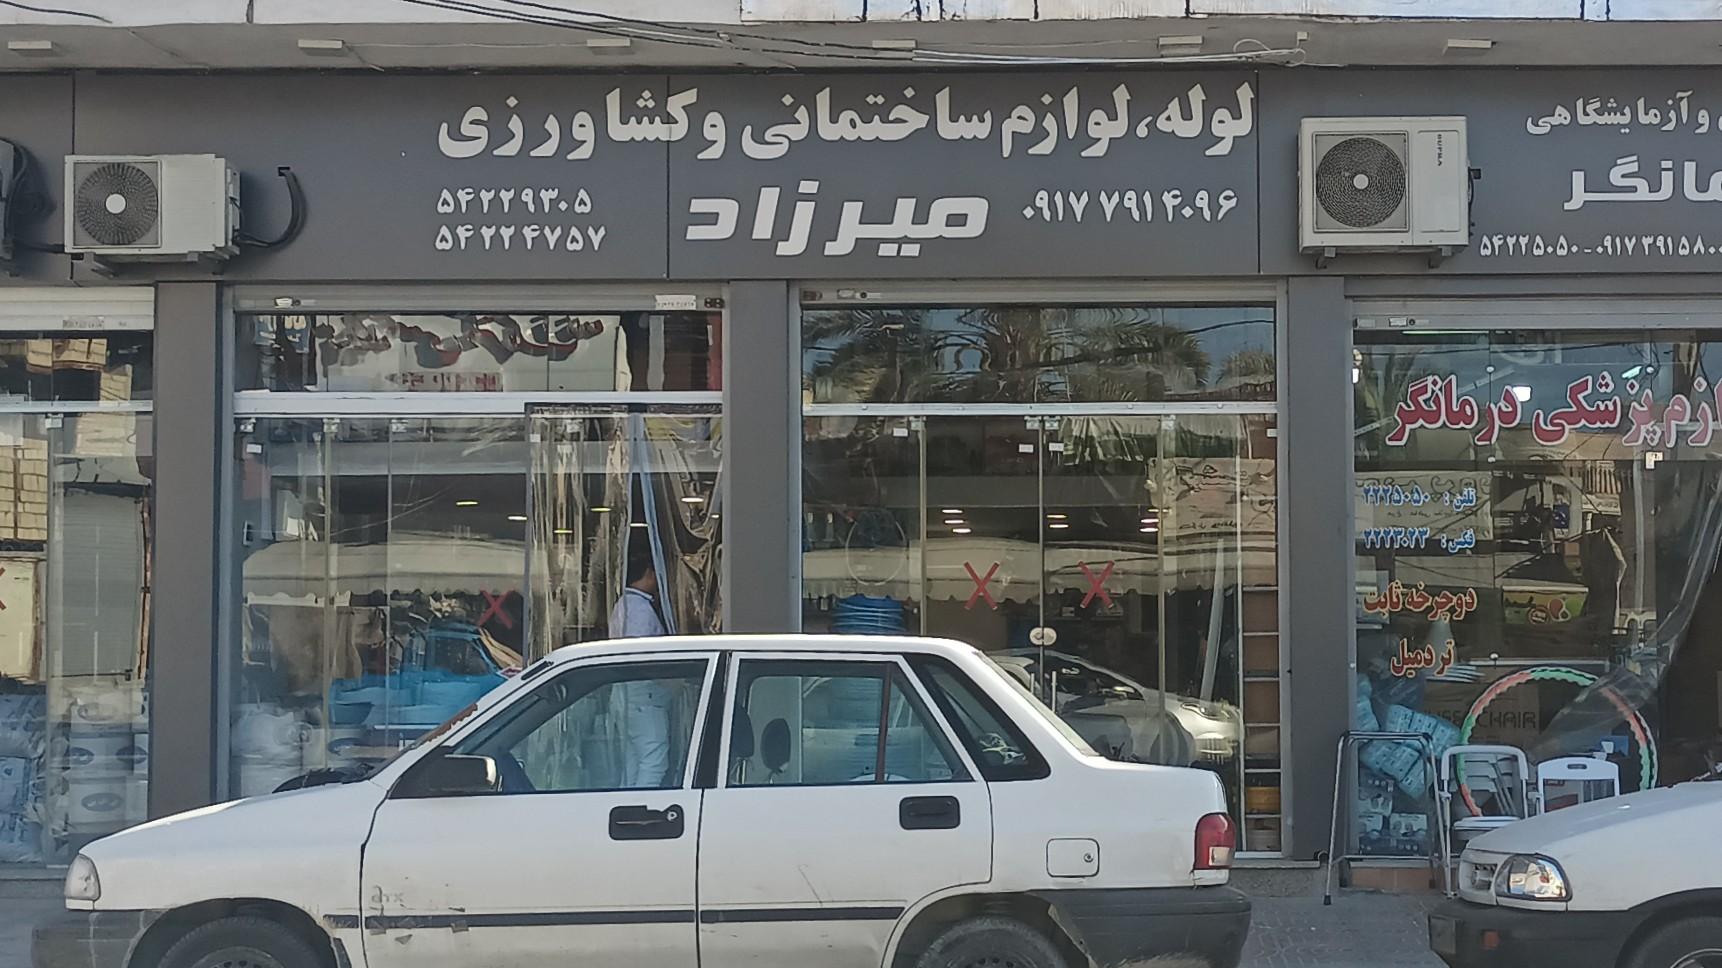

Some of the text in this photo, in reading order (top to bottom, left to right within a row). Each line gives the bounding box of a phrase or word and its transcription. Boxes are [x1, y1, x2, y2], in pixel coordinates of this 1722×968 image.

[741, 87, 992, 159] ساختمانی
[1001, 84, 1131, 158] لوازم
[1526, 90, 1693, 135] آزمایشگاهی
[436, 187, 593, 215] ۵۴۲۲۹۳۰۵
[685, 180, 990, 258] میرزاد
[434, 224, 607, 252] ۵۴۲۲۴۷۵۷
